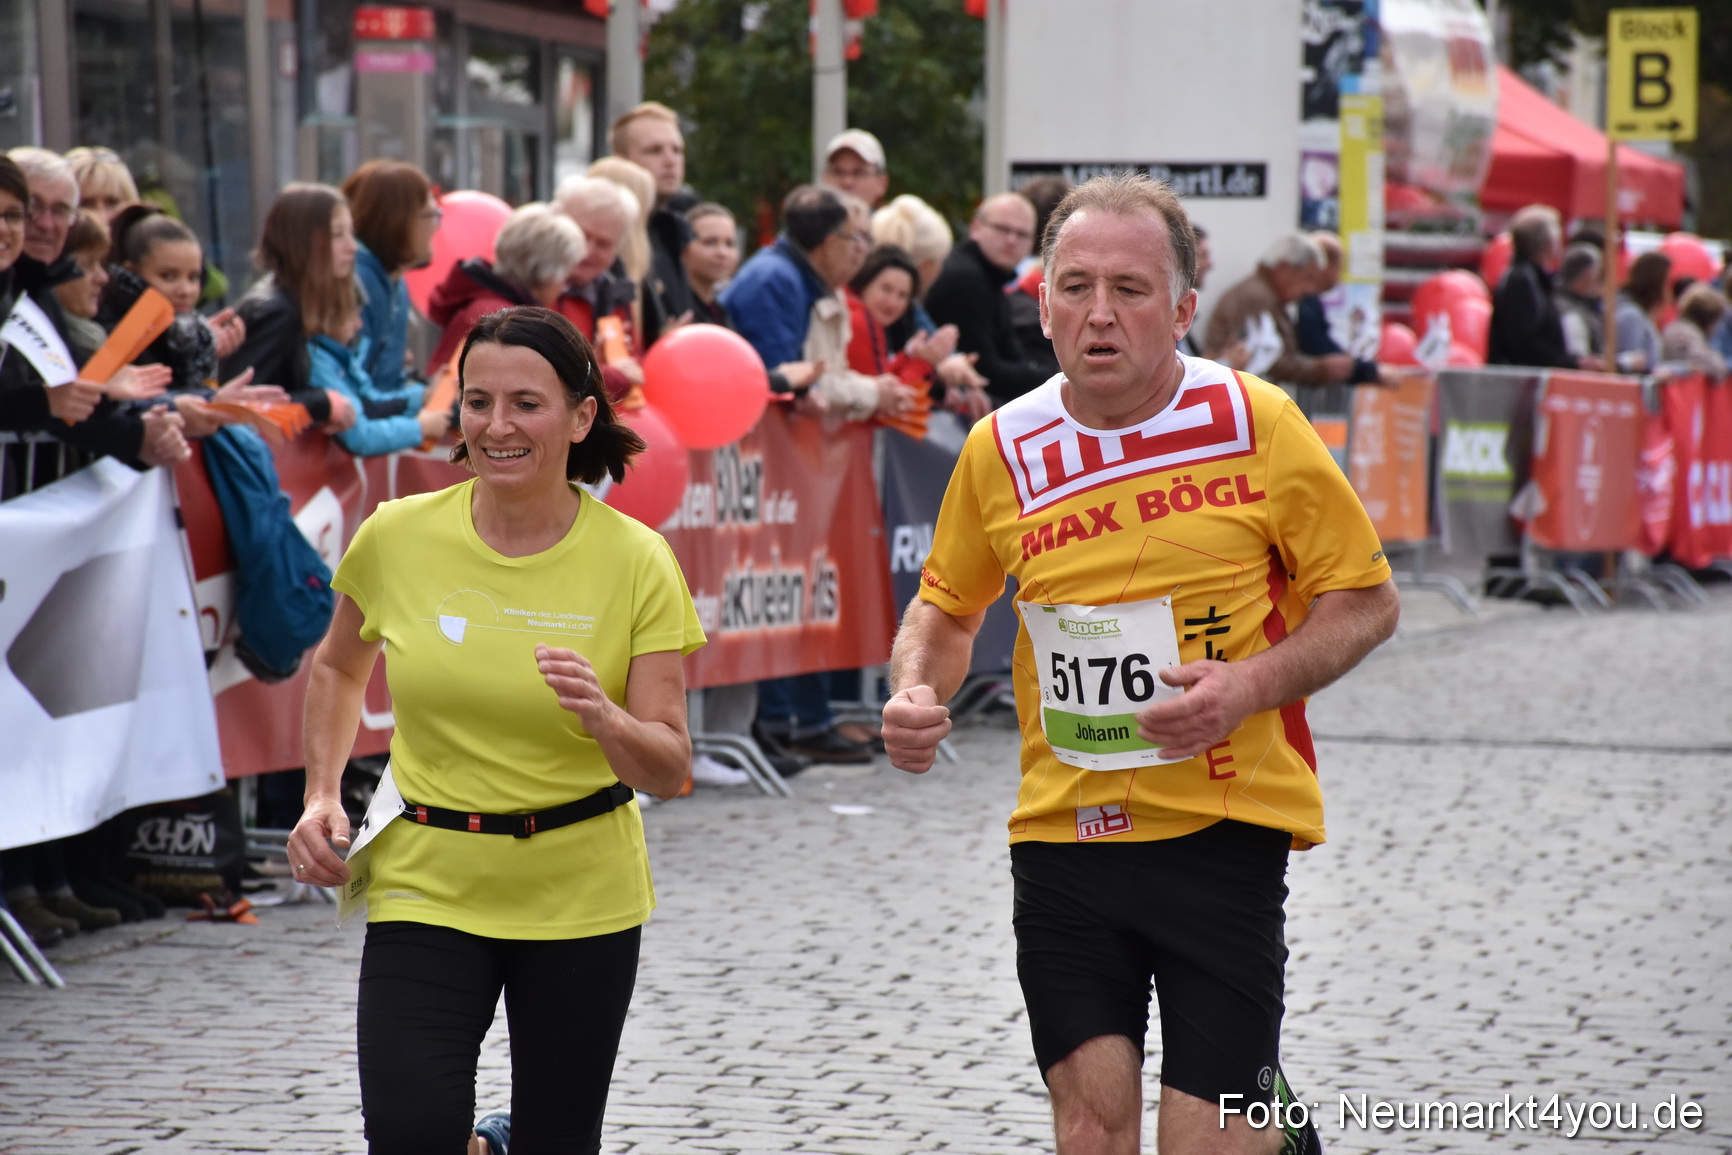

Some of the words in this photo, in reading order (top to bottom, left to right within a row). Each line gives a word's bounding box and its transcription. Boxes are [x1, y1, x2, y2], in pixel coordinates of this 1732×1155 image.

[1633, 52, 1673, 108] B
[1021, 501, 1124, 562] MAX
[1136, 474, 1267, 524] BÖGL
[504, 608, 537, 617] Kliniken
[538, 611, 552, 619] des
[553, 612, 596, 622] Landkreises
[527, 619, 567, 629] Neumarkt
[1067, 618, 1121, 636] BOCK
[1051, 652, 1155, 705] 5176
[1075, 722, 1130, 742] Johann
